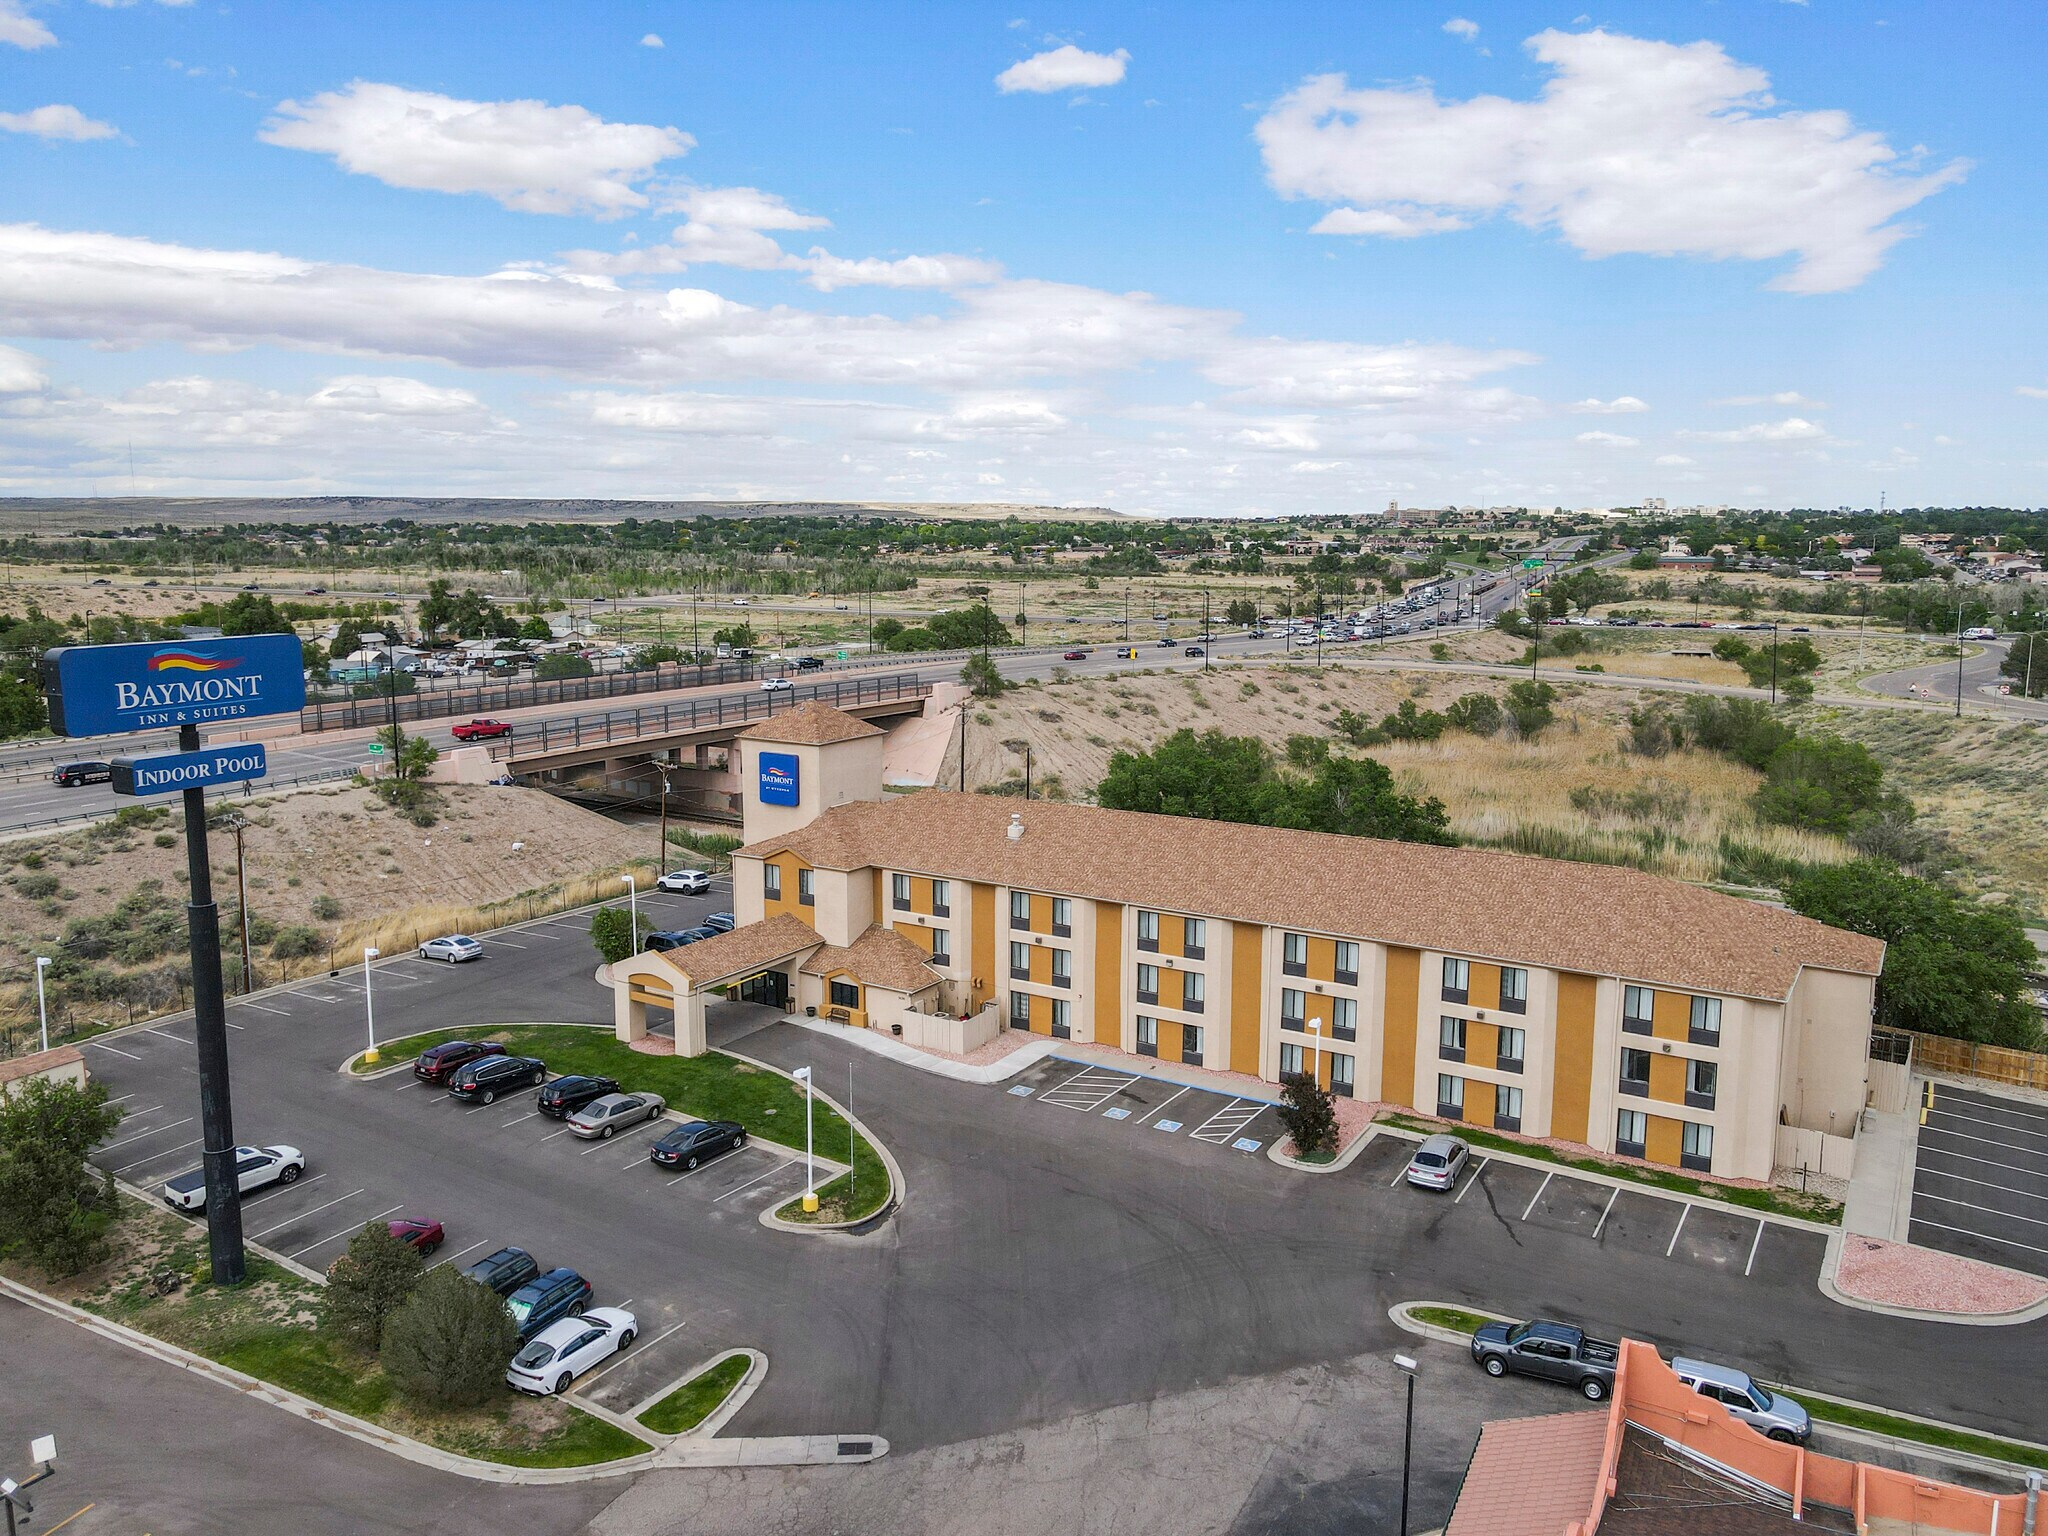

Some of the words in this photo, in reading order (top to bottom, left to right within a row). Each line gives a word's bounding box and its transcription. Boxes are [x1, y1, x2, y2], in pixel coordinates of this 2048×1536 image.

[115, 674, 262, 710] BAYMONT
[139, 713, 168, 725] INN
[176, 711, 187, 721] &
[193, 704, 246, 718] SUITES
[136, 763, 210, 787] INDOOR
[215, 755, 264, 776] POOL
[761, 774, 793, 785] BAYMONT
